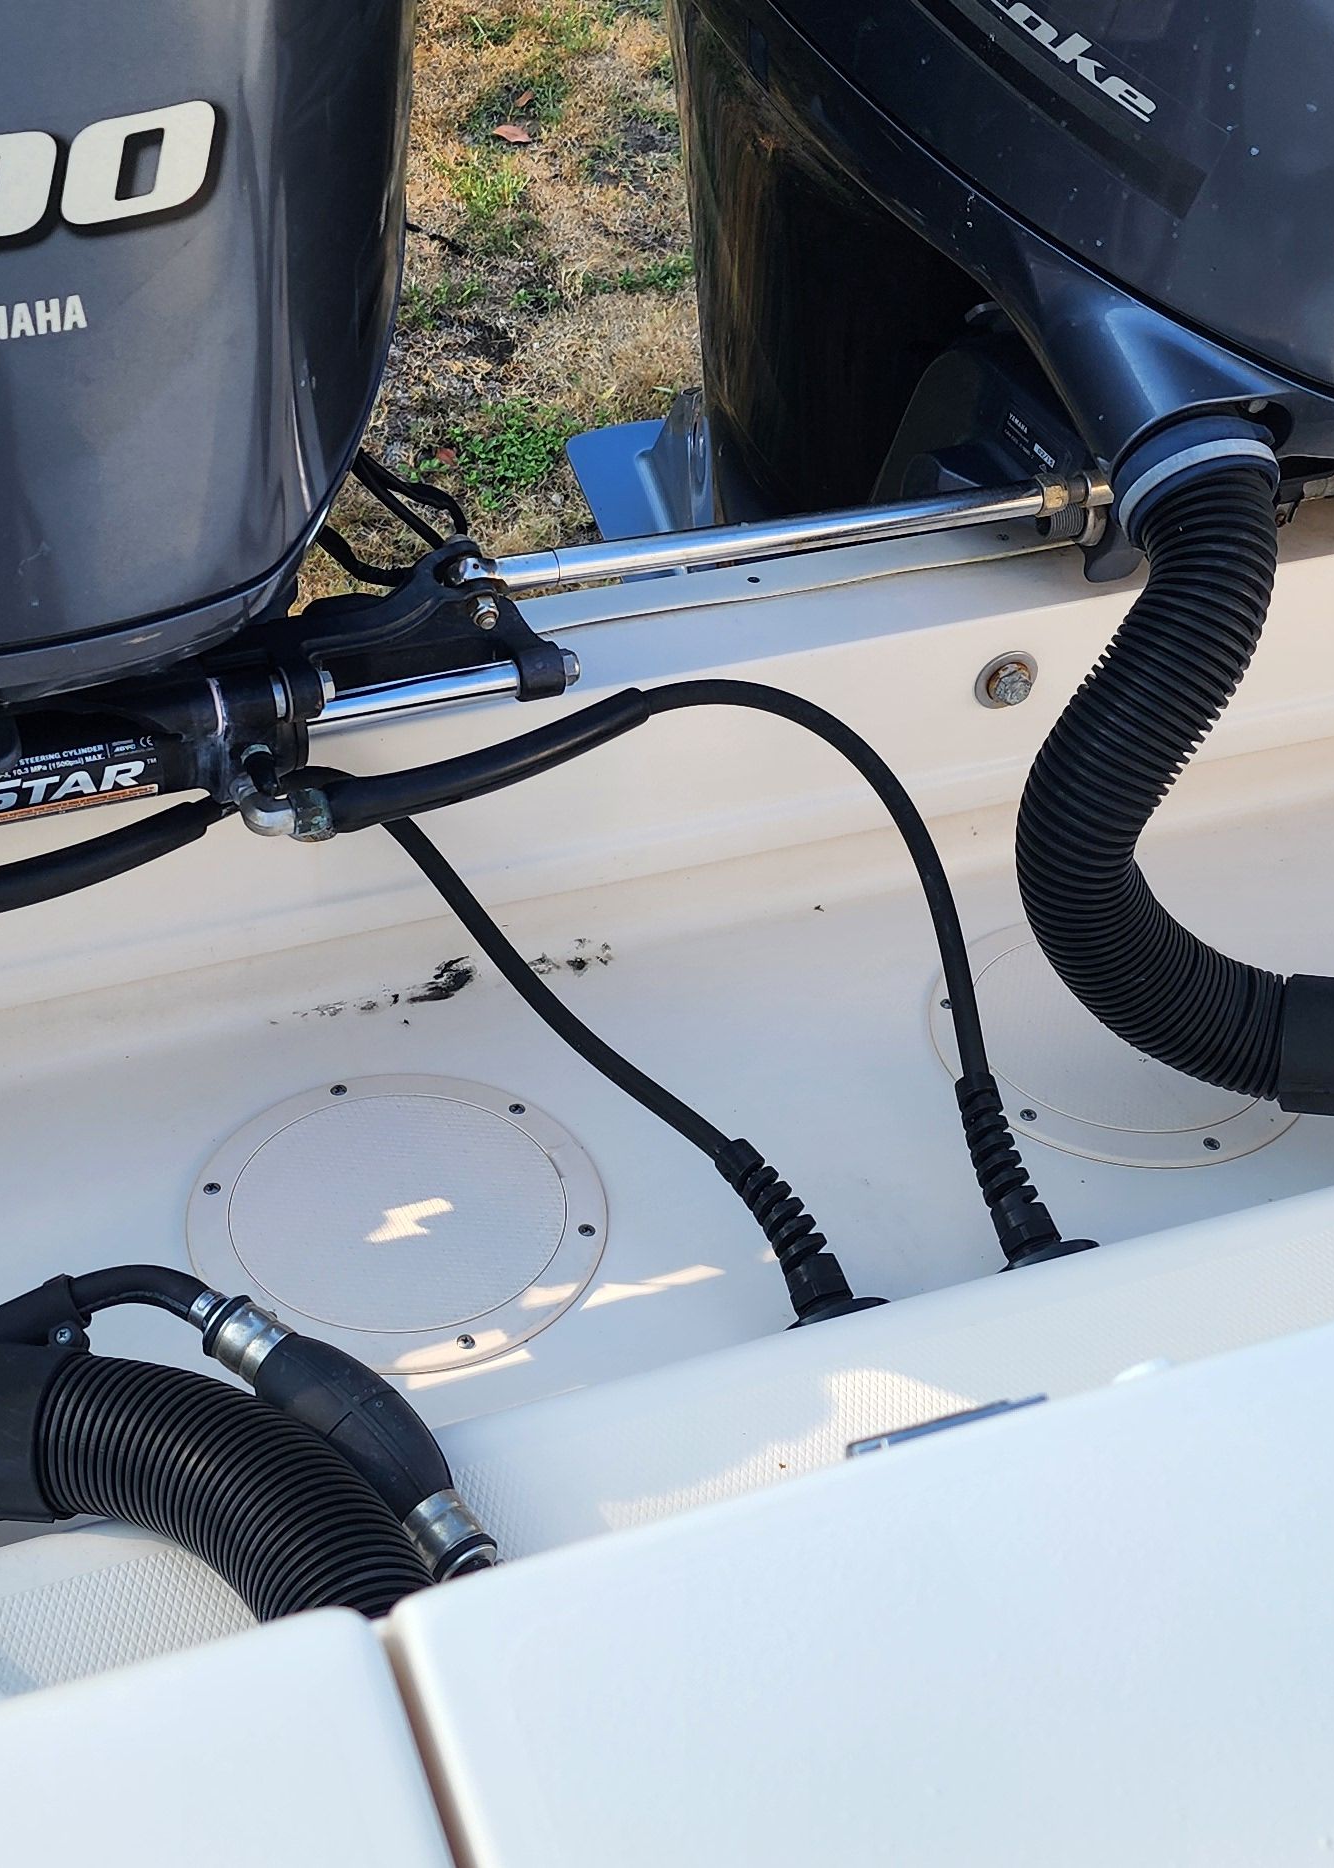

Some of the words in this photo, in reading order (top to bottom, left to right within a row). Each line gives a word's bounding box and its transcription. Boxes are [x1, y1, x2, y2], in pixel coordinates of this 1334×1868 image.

[991, 0, 1156, 123] oke
[19, 752, 61, 766] STEERING
[62, 744, 105, 758] CYLINDER
